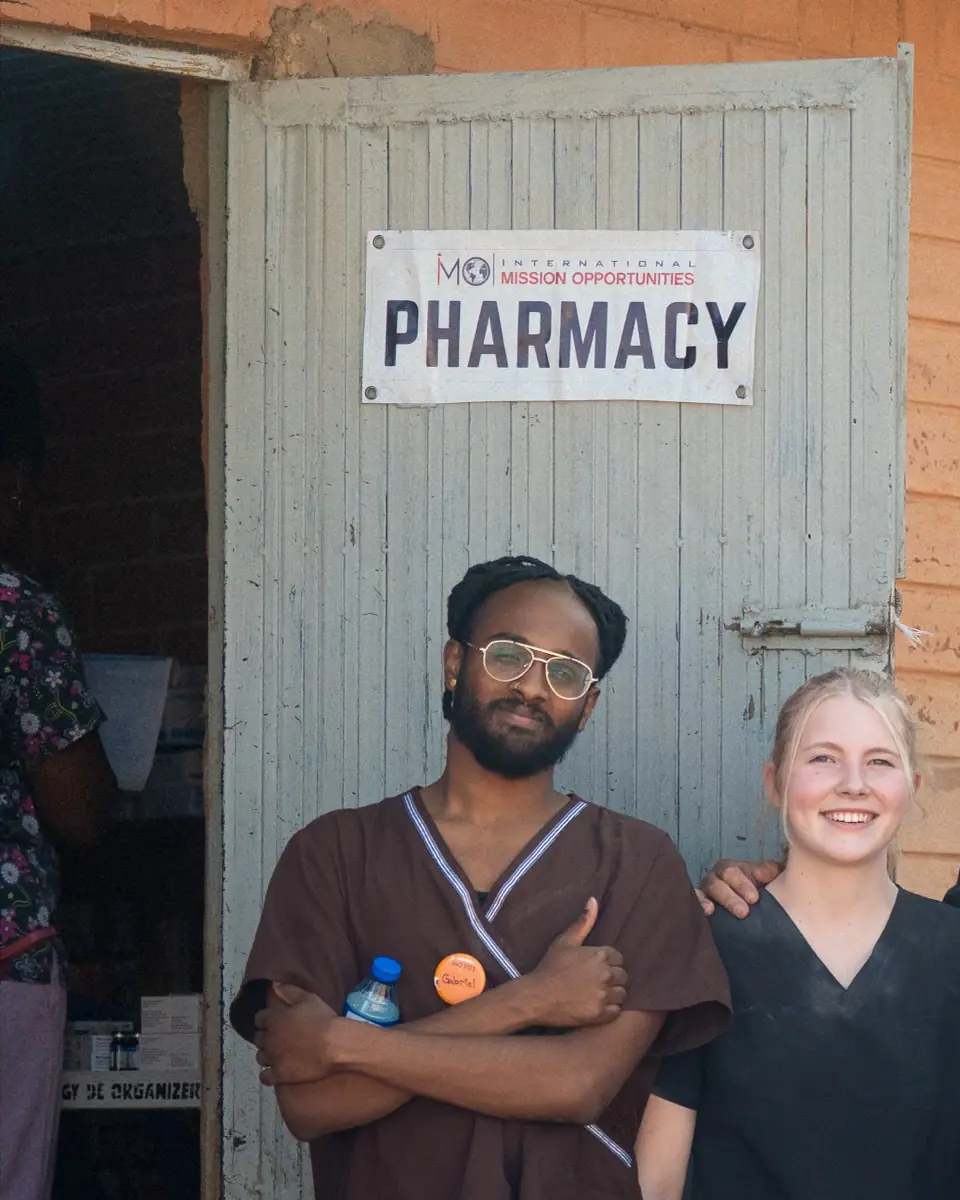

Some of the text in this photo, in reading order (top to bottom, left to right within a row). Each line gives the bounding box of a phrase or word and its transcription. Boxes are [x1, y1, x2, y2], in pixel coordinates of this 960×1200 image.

[502, 258, 696, 268] INTERNATIONAL
[501, 271, 695, 286] MISSION OPPORTUNITIES
[384, 299, 748, 370] PHARMACY
